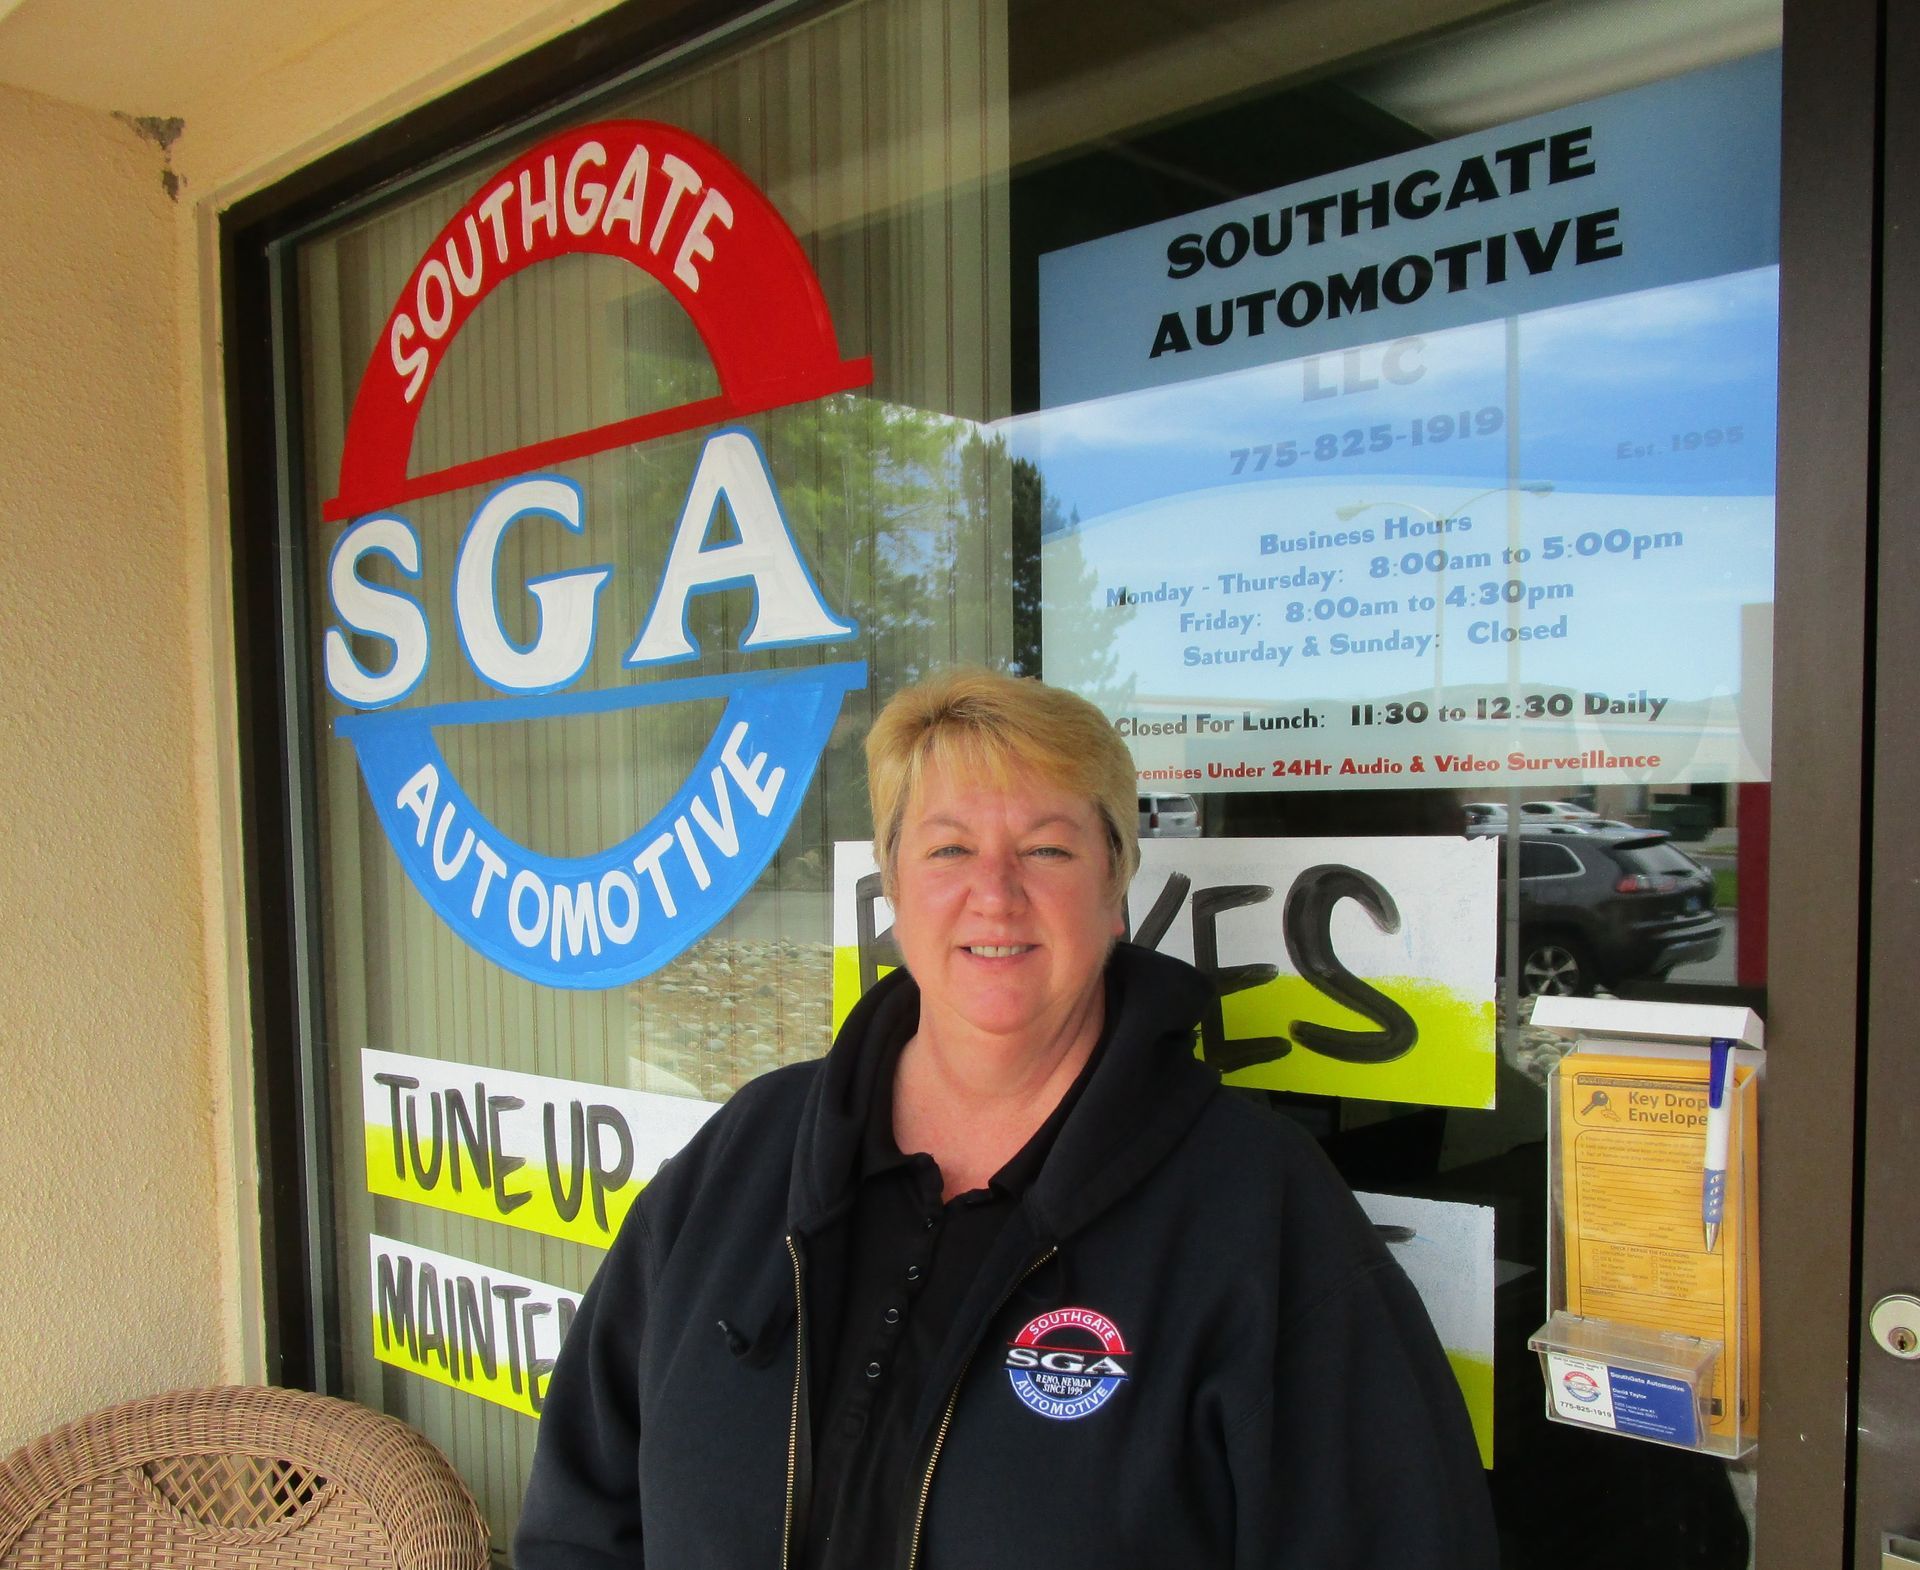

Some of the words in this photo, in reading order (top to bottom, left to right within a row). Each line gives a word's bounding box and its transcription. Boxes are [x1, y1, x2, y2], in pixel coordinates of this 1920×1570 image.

[1167, 126, 1595, 279] SOUTHGATE
[389, 141, 734, 402] SOUTHGATE
[1148, 208, 1623, 359] AUTOMOTIVE
[1302, 335, 1428, 402] LLC
[1229, 406, 1504, 475] 775-825-1919
[1670, 425, 1744, 452] 1995
[1260, 528, 1375, 555] Business
[1384, 514, 1472, 540] Hours
[323, 427, 859, 710] SGA
[1106, 581, 1193, 607] Monday
[1218, 566, 1343, 594] Thursday:
[1369, 549, 1491, 579] 8:00am
[1502, 546, 1531, 565] to
[1542, 528, 1683, 560] 5:00pm
[1180, 609, 1261, 635] Friday:
[1285, 596, 1398, 623] 8:00am
[1408, 594, 1435, 612] to
[1445, 579, 1574, 610] 4:30pm
[1183, 641, 1293, 667] Saturday
[1302, 635, 1320, 657] &
[1330, 629, 1440, 657] Sunday:
[1467, 615, 1568, 645] Closed
[1114, 714, 1187, 738] Closed
[1195, 713, 1235, 734] For
[1242, 708, 1325, 732] Lunch:
[1351, 701, 1428, 727] 11:30
[1438, 705, 1466, 723] to
[1476, 693, 1573, 721] 12:30
[1584, 690, 1669, 722] Daily
[1136, 764, 1202, 780] remises
[1207, 761, 1266, 780] Under
[1272, 759, 1333, 777] 24Hr
[1339, 756, 1403, 775] Audio
[1410, 755, 1425, 773] &
[1434, 754, 1500, 773] Video
[1507, 750, 1661, 771] Surveillance
[397, 721, 785, 962] AUTOMOTIVE
[1629, 1091, 1659, 1109] Key
[1665, 1092, 1708, 1112] Drop
[373, 1072, 533, 1216] TUNE
[543, 1098, 635, 1235] UP
[1029, 1311, 1116, 1342] SOUTHGATE
[1005, 1348, 1128, 1376] SGA
[1061, 1376, 1092, 1388] NEVADA
[1016, 1380, 1109, 1416] AUTOMOTIVE
[1042, 1383, 1066, 1395] SINCE
[1067, 1385, 1083, 1395] 1995
